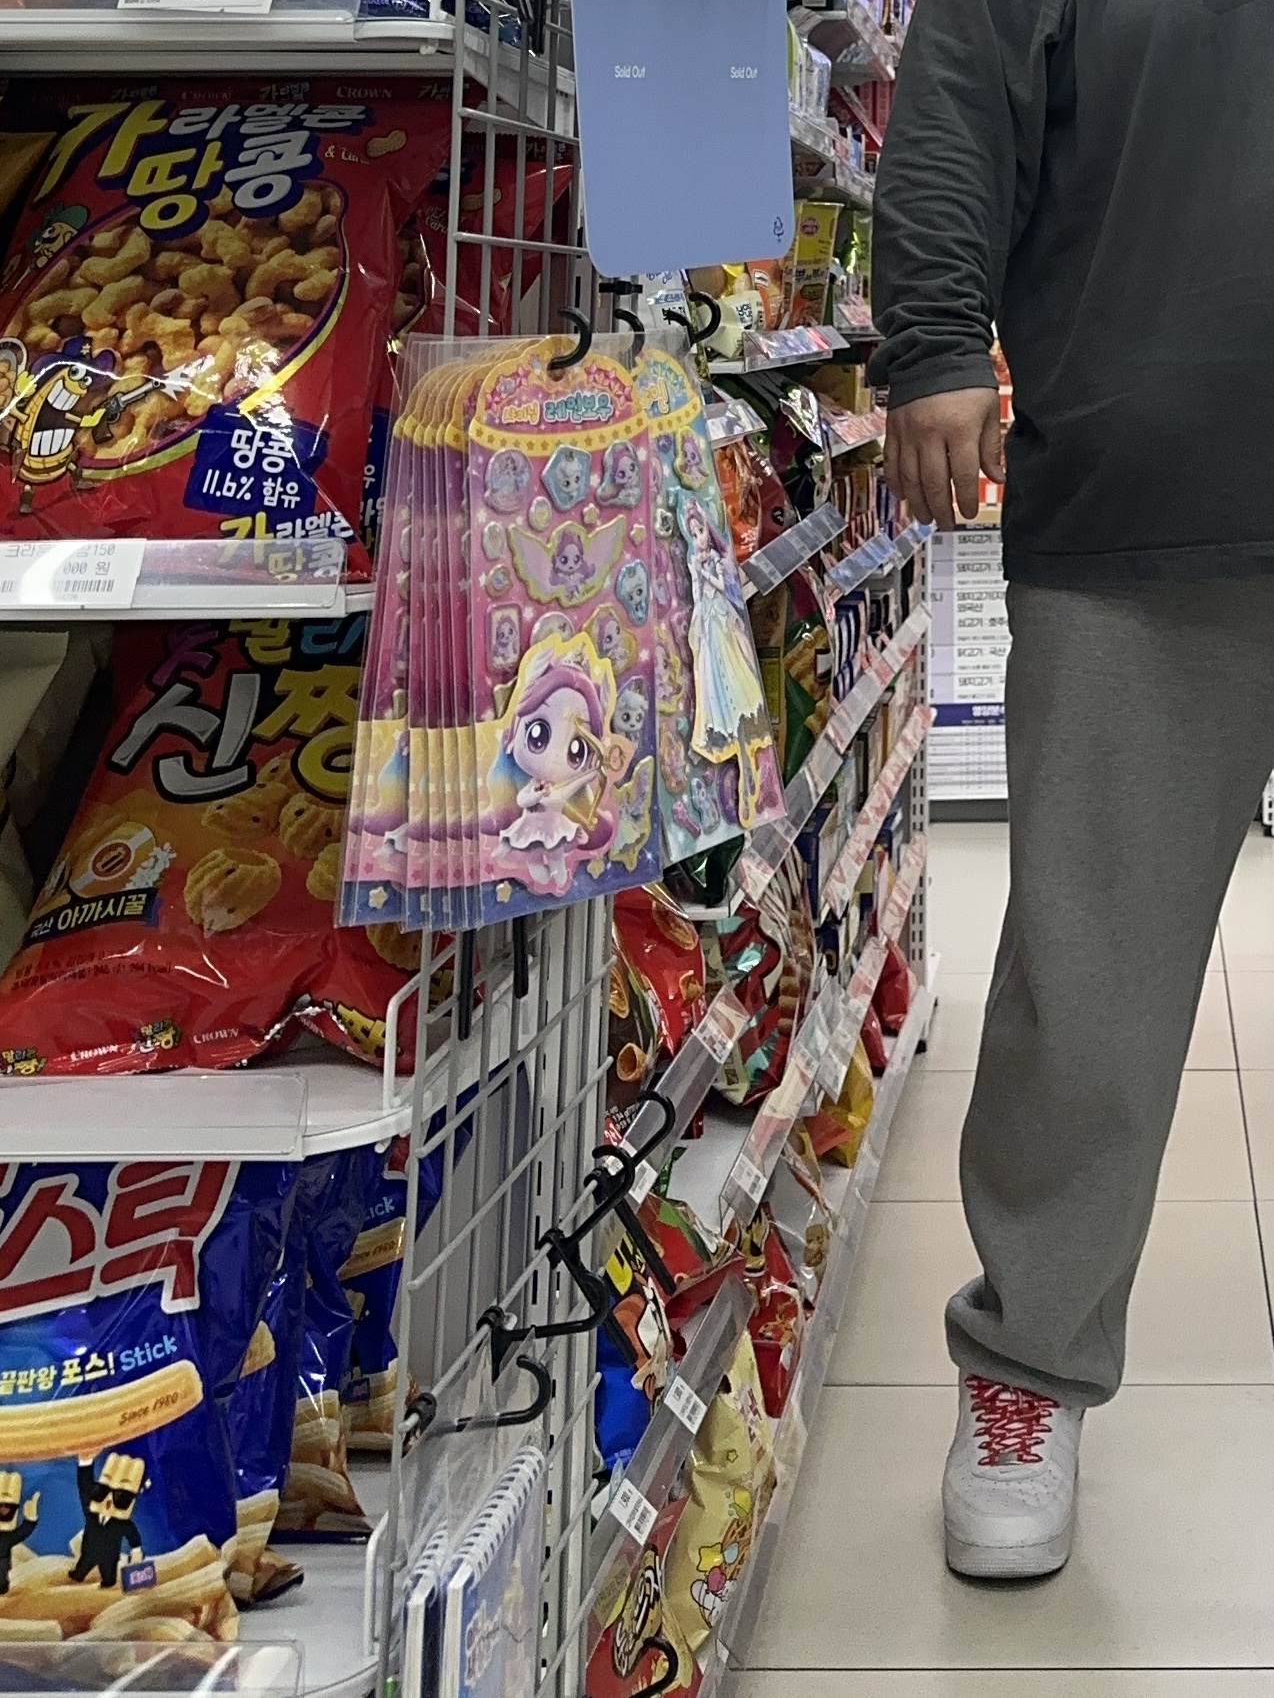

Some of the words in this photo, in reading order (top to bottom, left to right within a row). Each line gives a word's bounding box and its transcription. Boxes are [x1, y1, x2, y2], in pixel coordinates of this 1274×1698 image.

[615, 65, 631, 79] Sold
[632, 65, 646, 79] Out
[730, 66, 744, 79] Sold
[745, 66, 757, 79] Out
[34, 100, 366, 202] 카라멜콘
[126, 130, 312, 230] 땅콩
[544, 392, 614, 423] 레인보우
[231, 431, 292, 472] 땅콩
[203, 470, 252, 502] 11.6%
[262, 476, 301, 509] 함유
[57, 893, 147, 931] 아까시꿀
[193, 1028, 239, 1044] CROWN
[0, 1162, 233, 1311] 스틱
[61, 1352, 115, 1386] 포스!
[120, 1336, 178, 1371] Stick
